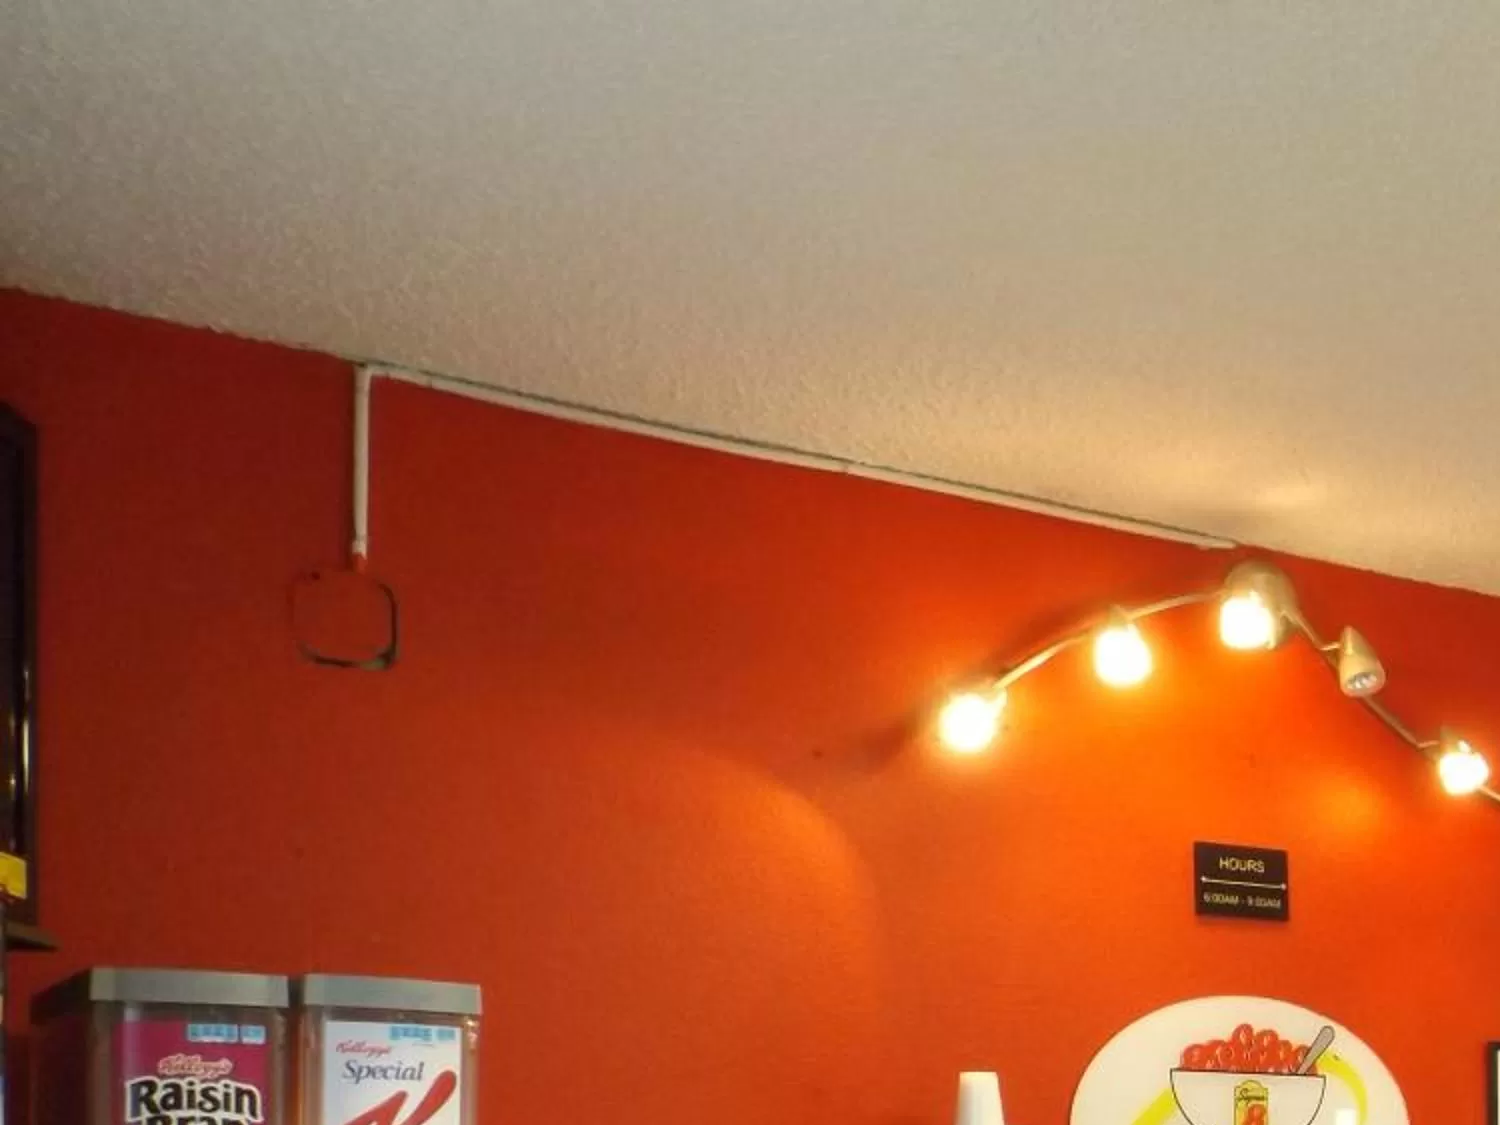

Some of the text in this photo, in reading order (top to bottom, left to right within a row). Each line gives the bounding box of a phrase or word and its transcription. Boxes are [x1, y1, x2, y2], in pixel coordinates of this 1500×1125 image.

[1219, 857, 1265, 874] HOURS
[342, 1060, 425, 1084] Special
[128, 1079, 261, 1121] Raisin
